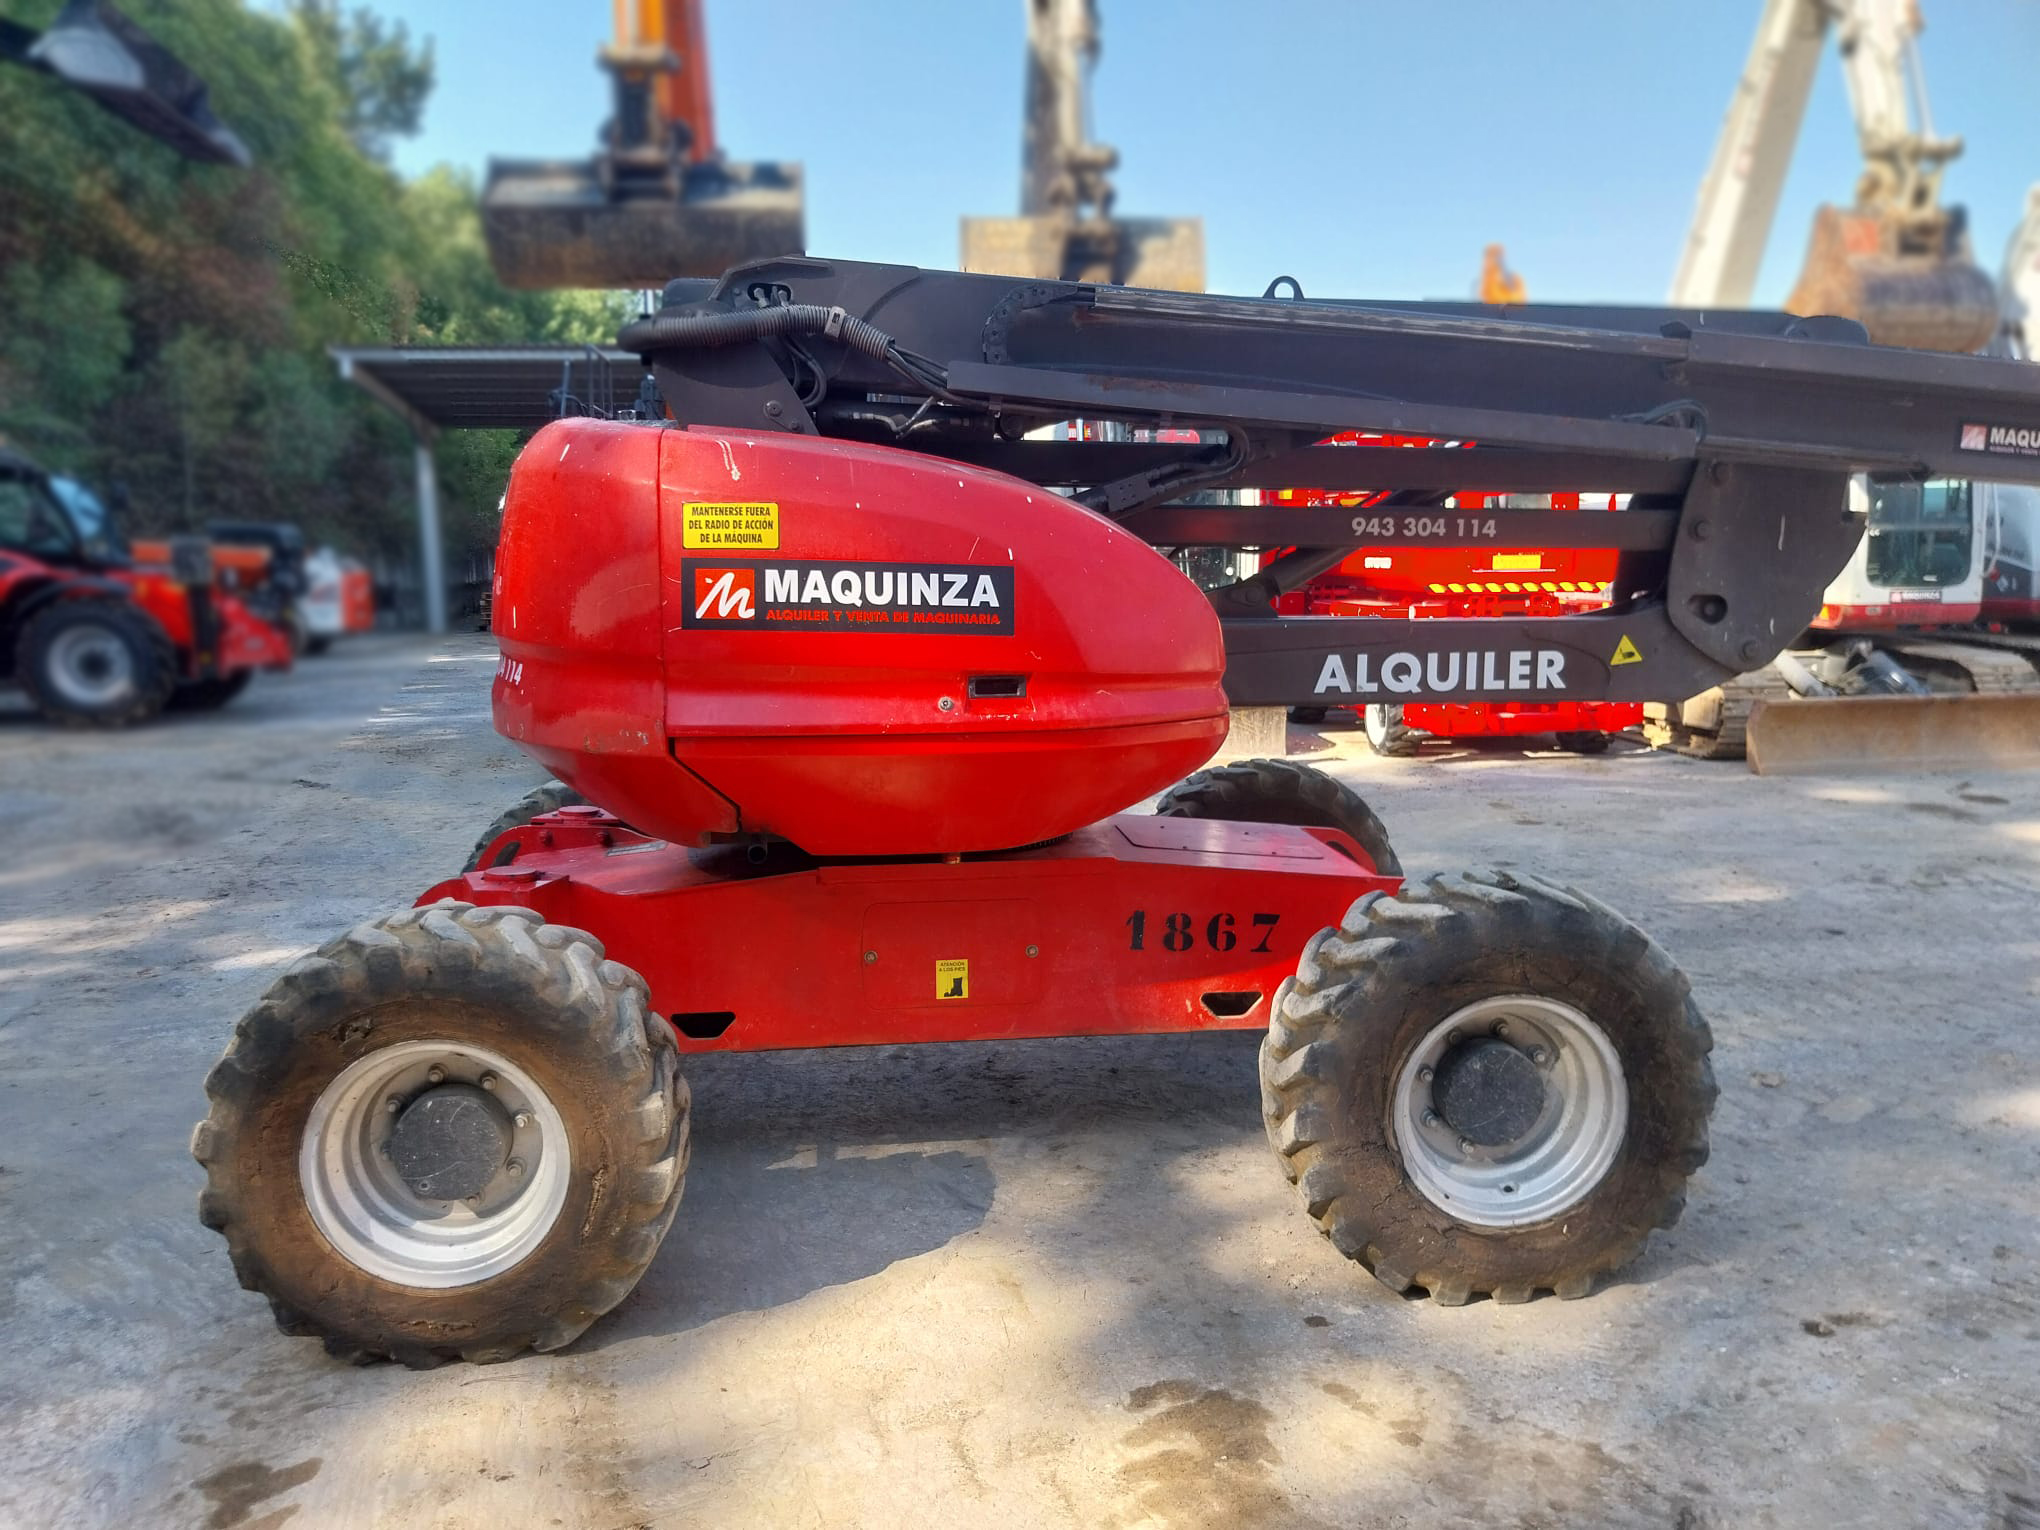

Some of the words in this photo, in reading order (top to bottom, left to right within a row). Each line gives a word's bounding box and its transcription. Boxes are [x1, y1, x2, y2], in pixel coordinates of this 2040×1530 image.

[692, 506, 743, 516] MANTENERSE
[745, 506, 771, 516] FUERA
[688, 519, 702, 530] DEL
[705, 519, 730, 530] RADIO
[732, 519, 742, 530] DE
[745, 517, 774, 530] ACCIÓN
[1351, 517, 1395, 537] 943
[1402, 518, 1447, 537] 304
[1456, 519, 1497, 538] 114
[700, 533, 710, 543] DE
[712, 533, 722, 543] LA
[764, 568, 1000, 608] MAQUINZA
[766, 609, 830, 622] ALQUILER
[846, 611, 890, 624] VENTA
[893, 611, 909, 624] DE
[913, 612, 1001, 625] MAQUINARIA
[1313, 650, 1567, 694] ALQUILER
[1125, 909, 1281, 953] 1867
